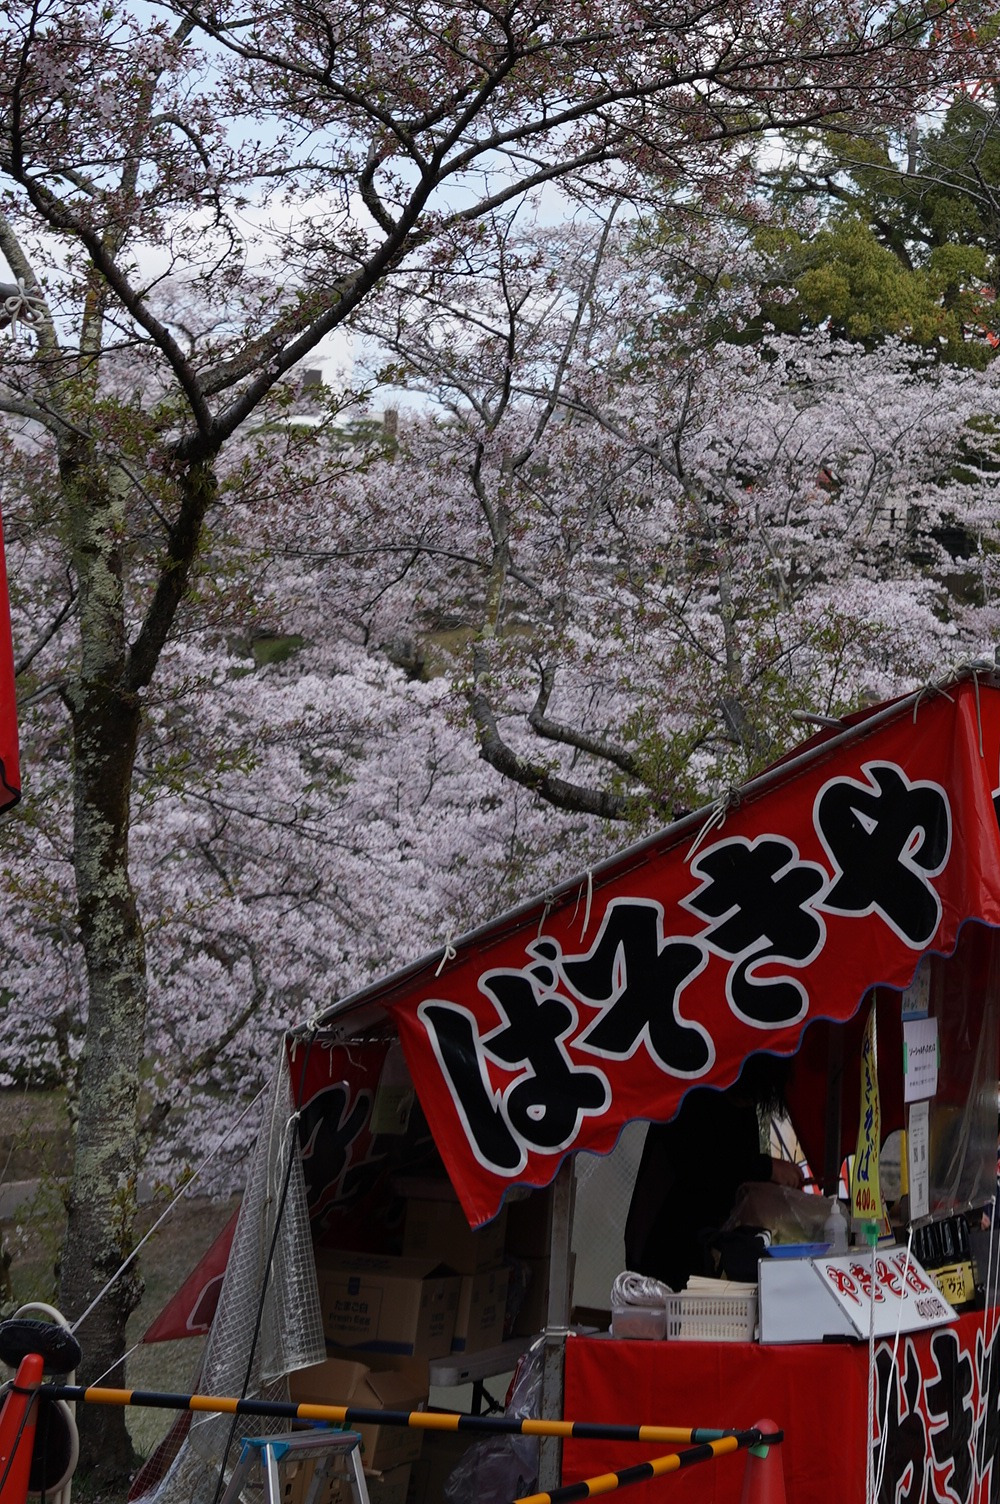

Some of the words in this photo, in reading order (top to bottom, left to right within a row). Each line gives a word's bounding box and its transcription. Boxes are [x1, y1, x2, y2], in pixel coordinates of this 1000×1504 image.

[826, 1252, 933, 1307] やきそば
[914, 1296, 949, 1321] 400円
